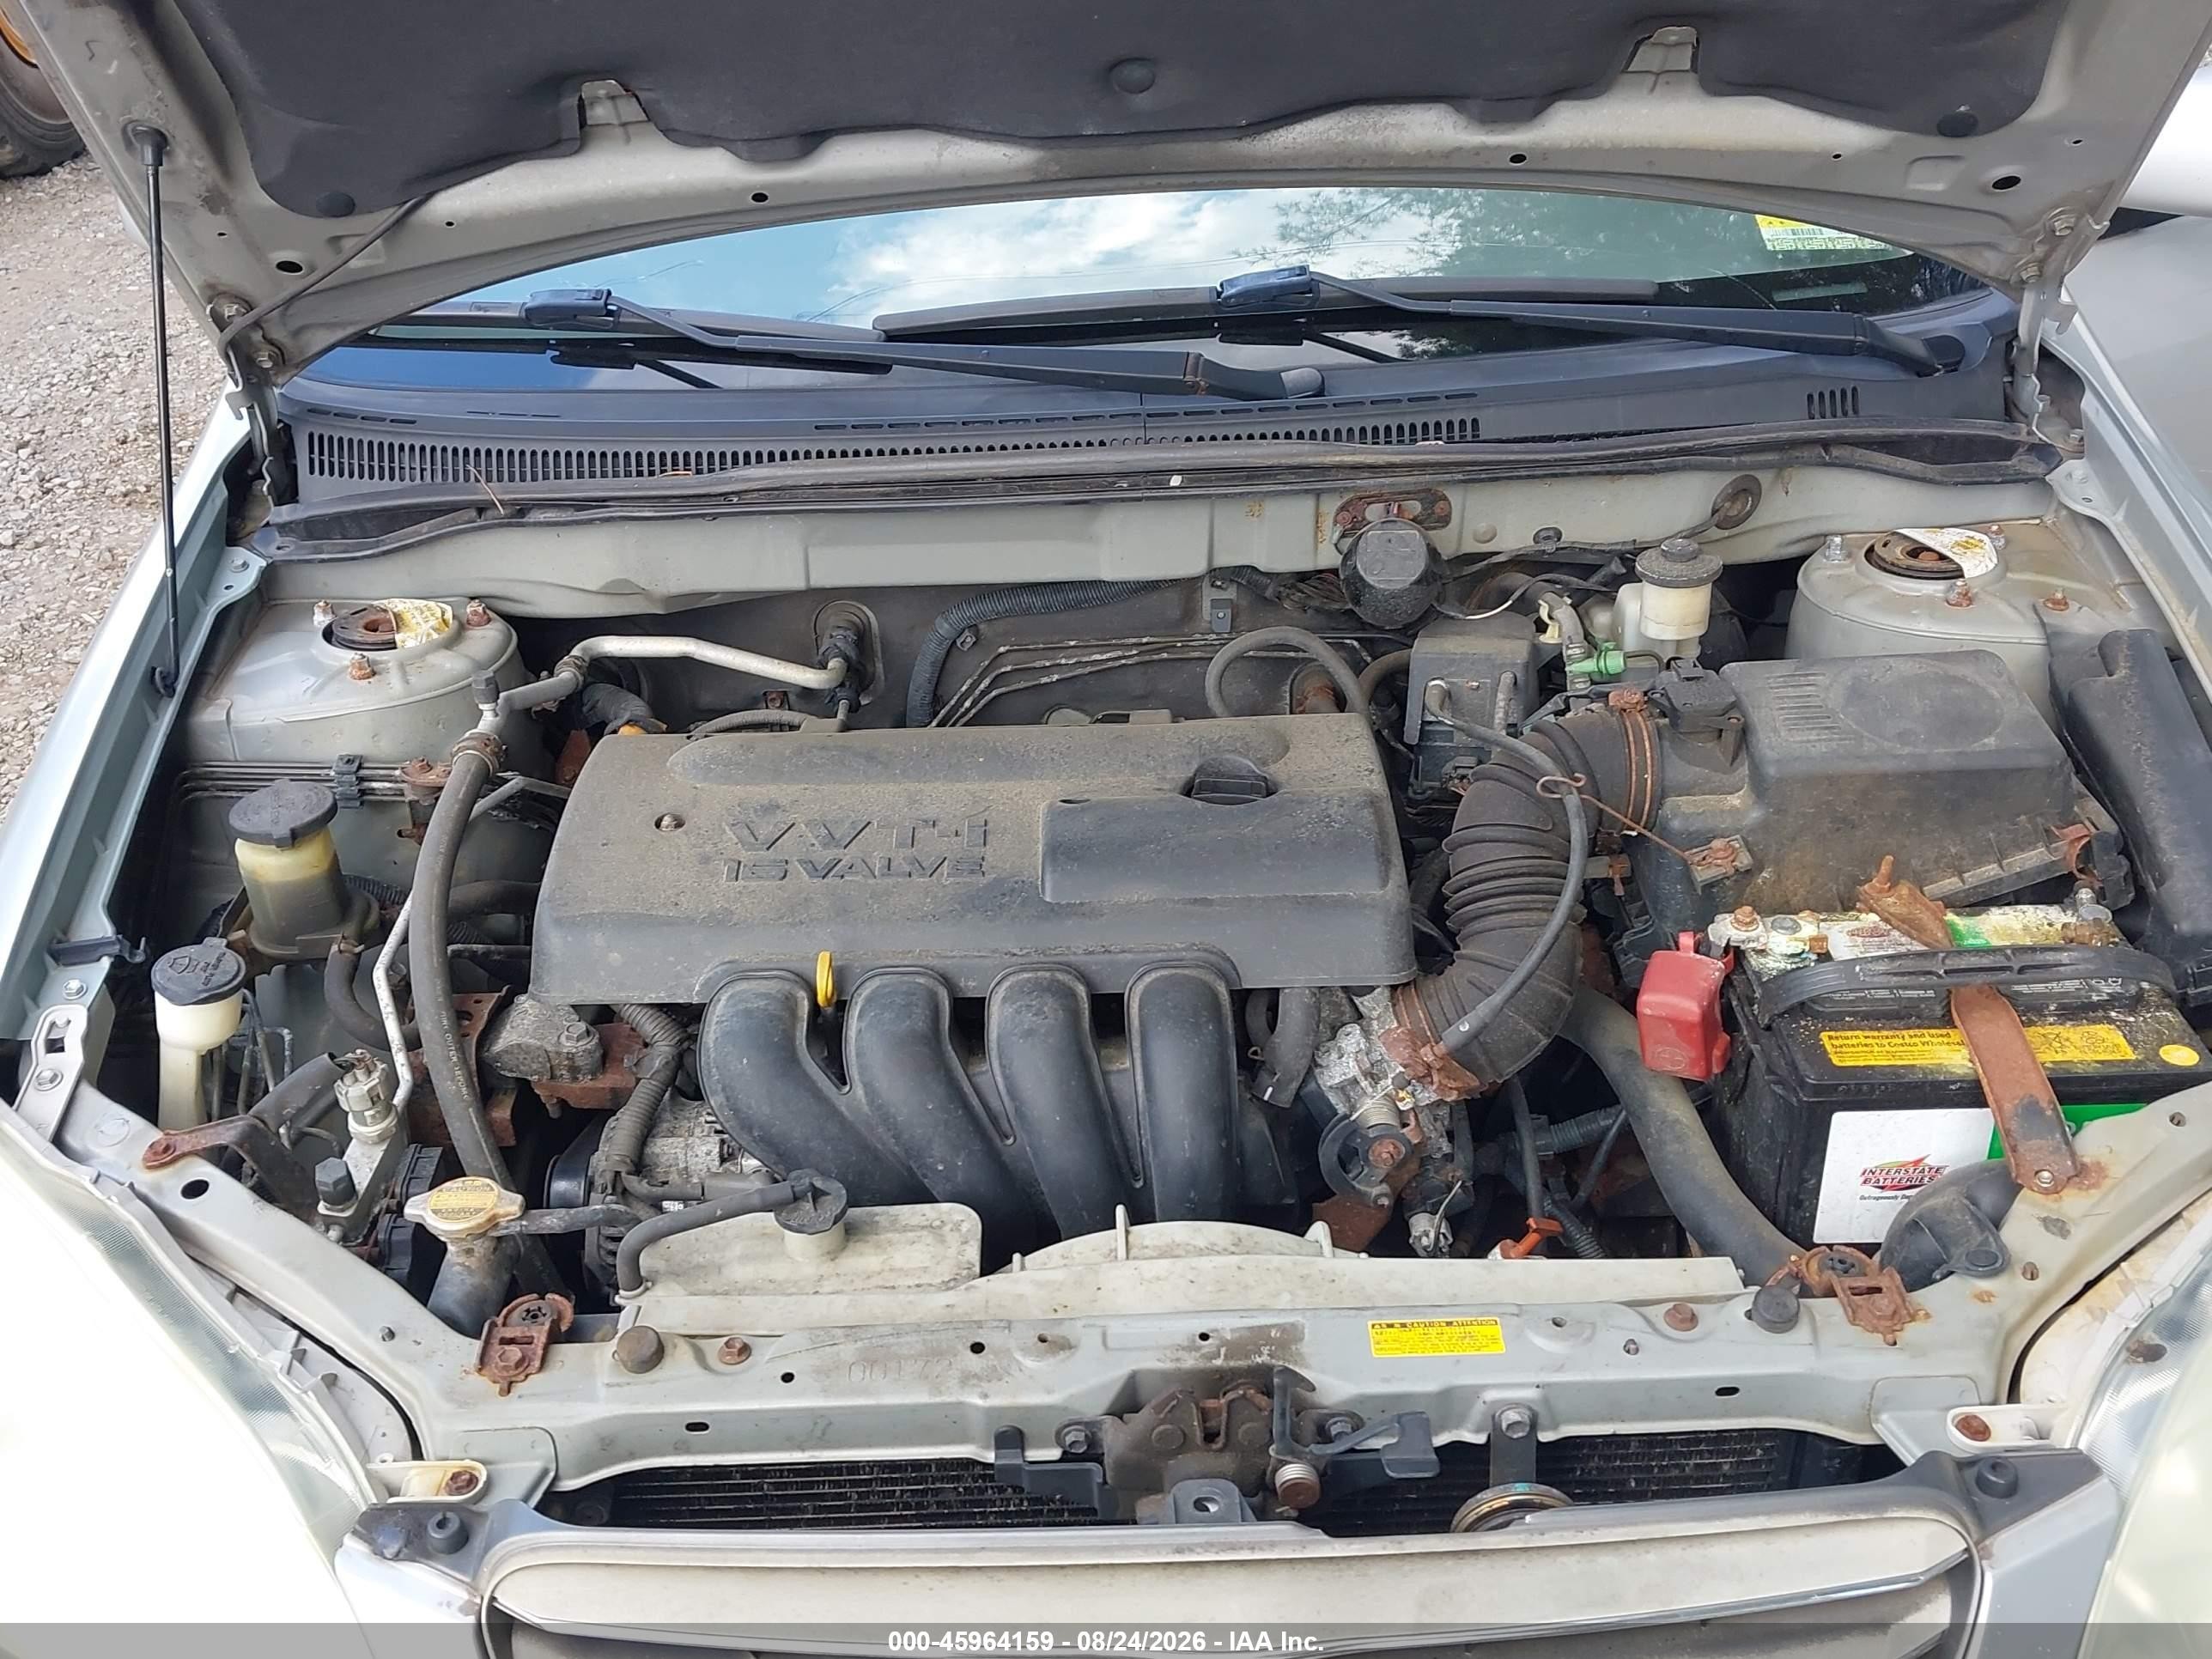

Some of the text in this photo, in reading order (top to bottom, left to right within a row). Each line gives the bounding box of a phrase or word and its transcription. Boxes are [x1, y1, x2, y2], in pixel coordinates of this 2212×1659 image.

[1863, 1033, 1905, 1042] warranty
[1831, 1041, 1875, 1049] batteries
[1889, 1040, 1919, 1048] Costco
[1861, 1167, 1945, 1176] INTERSTATE
[1862, 1176, 1936, 1185] BATTERIES
